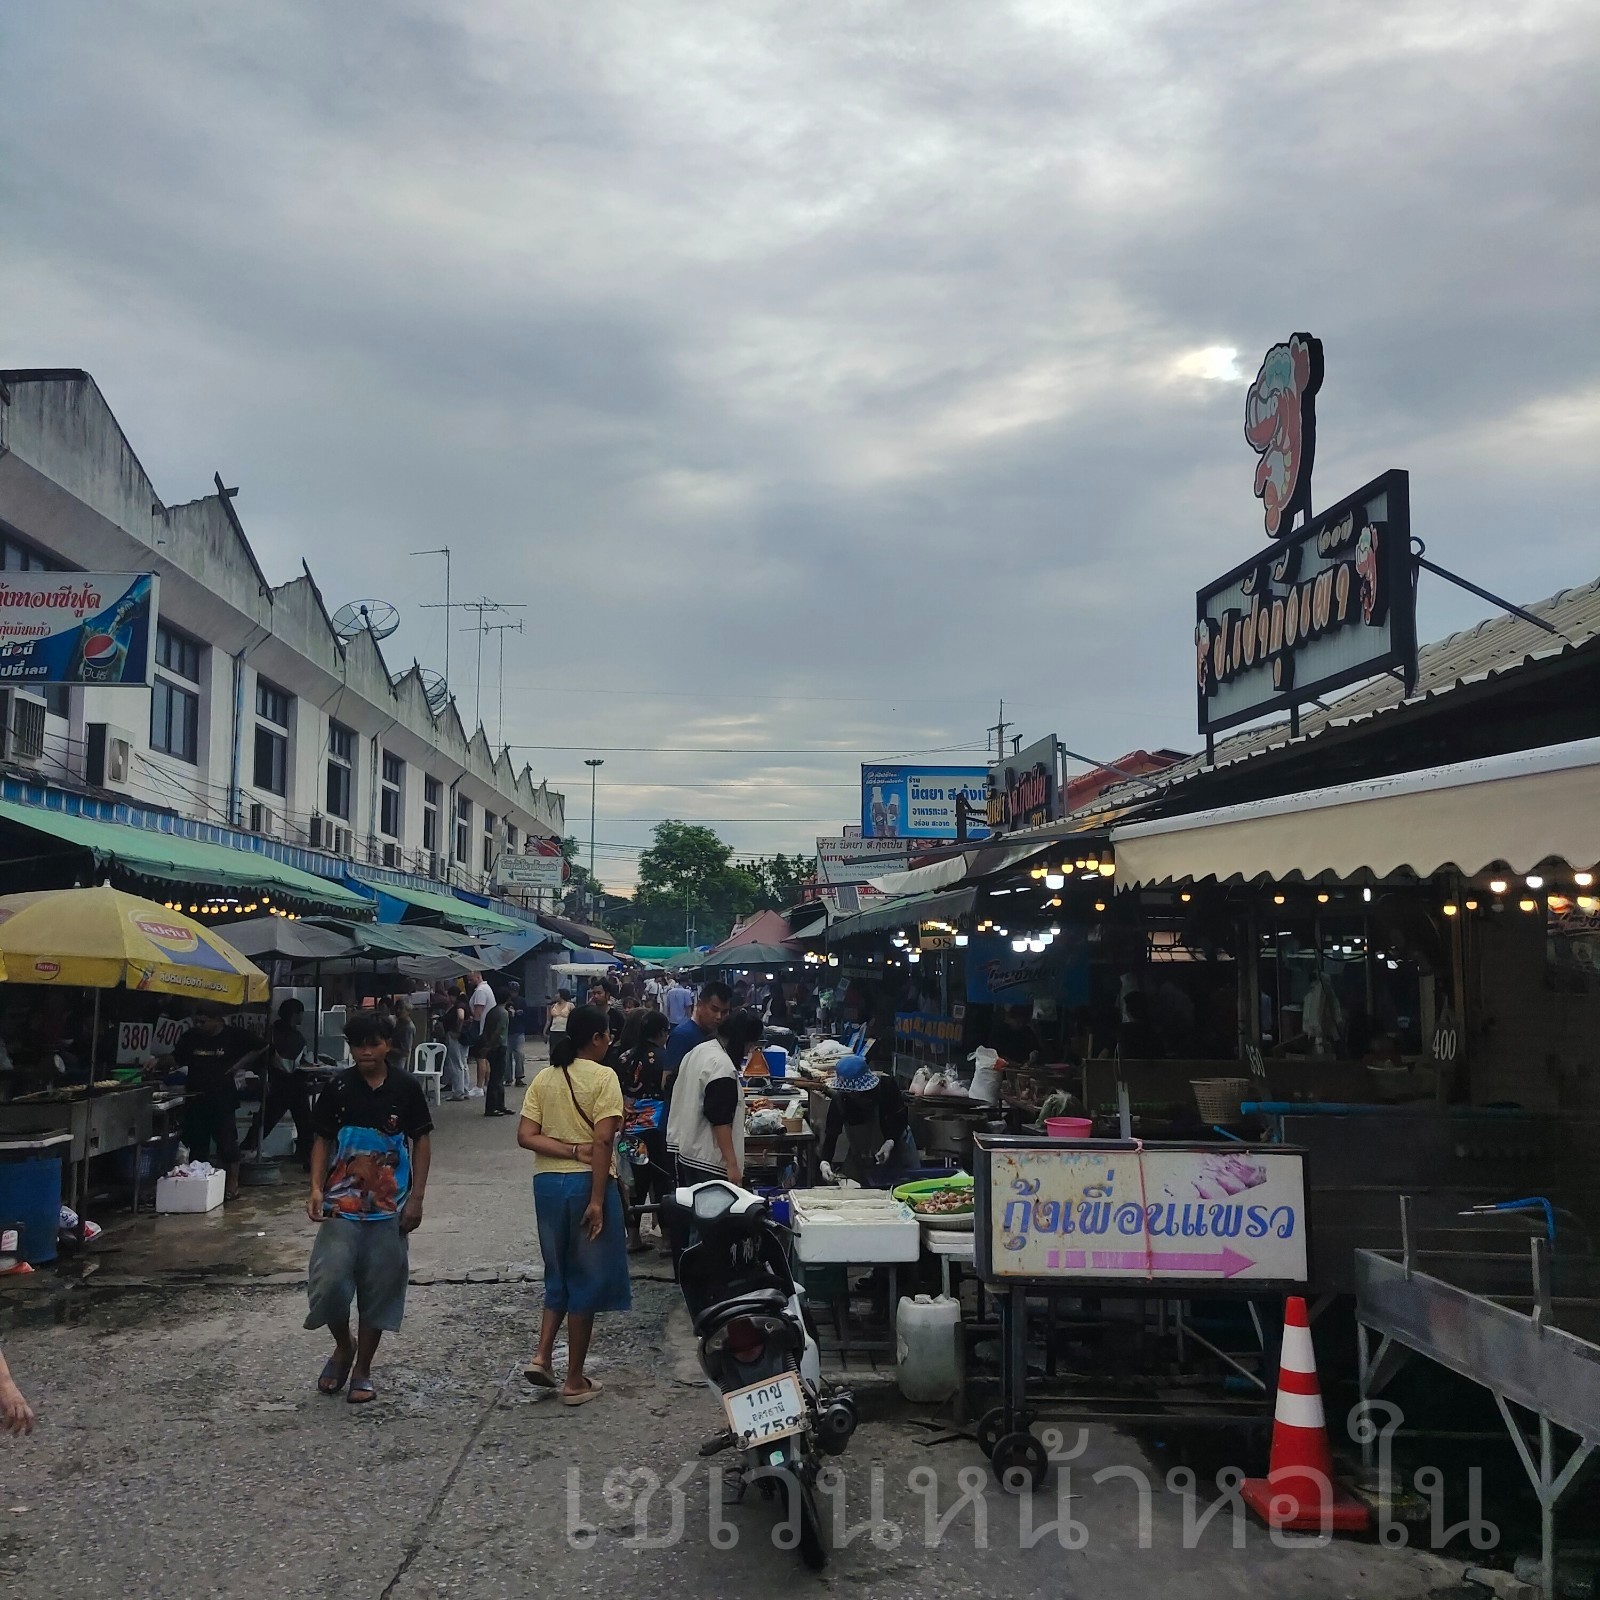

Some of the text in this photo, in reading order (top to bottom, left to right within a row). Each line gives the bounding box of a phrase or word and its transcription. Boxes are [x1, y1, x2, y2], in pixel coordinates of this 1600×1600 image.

[0, 582, 102, 618] ้งทองซีฟู้ด
[121, 1024, 149, 1051] 380
[1432, 1029, 1457, 1061] 400
[1003, 1169, 1296, 1251] กุ้งเพื่อนแพรว
